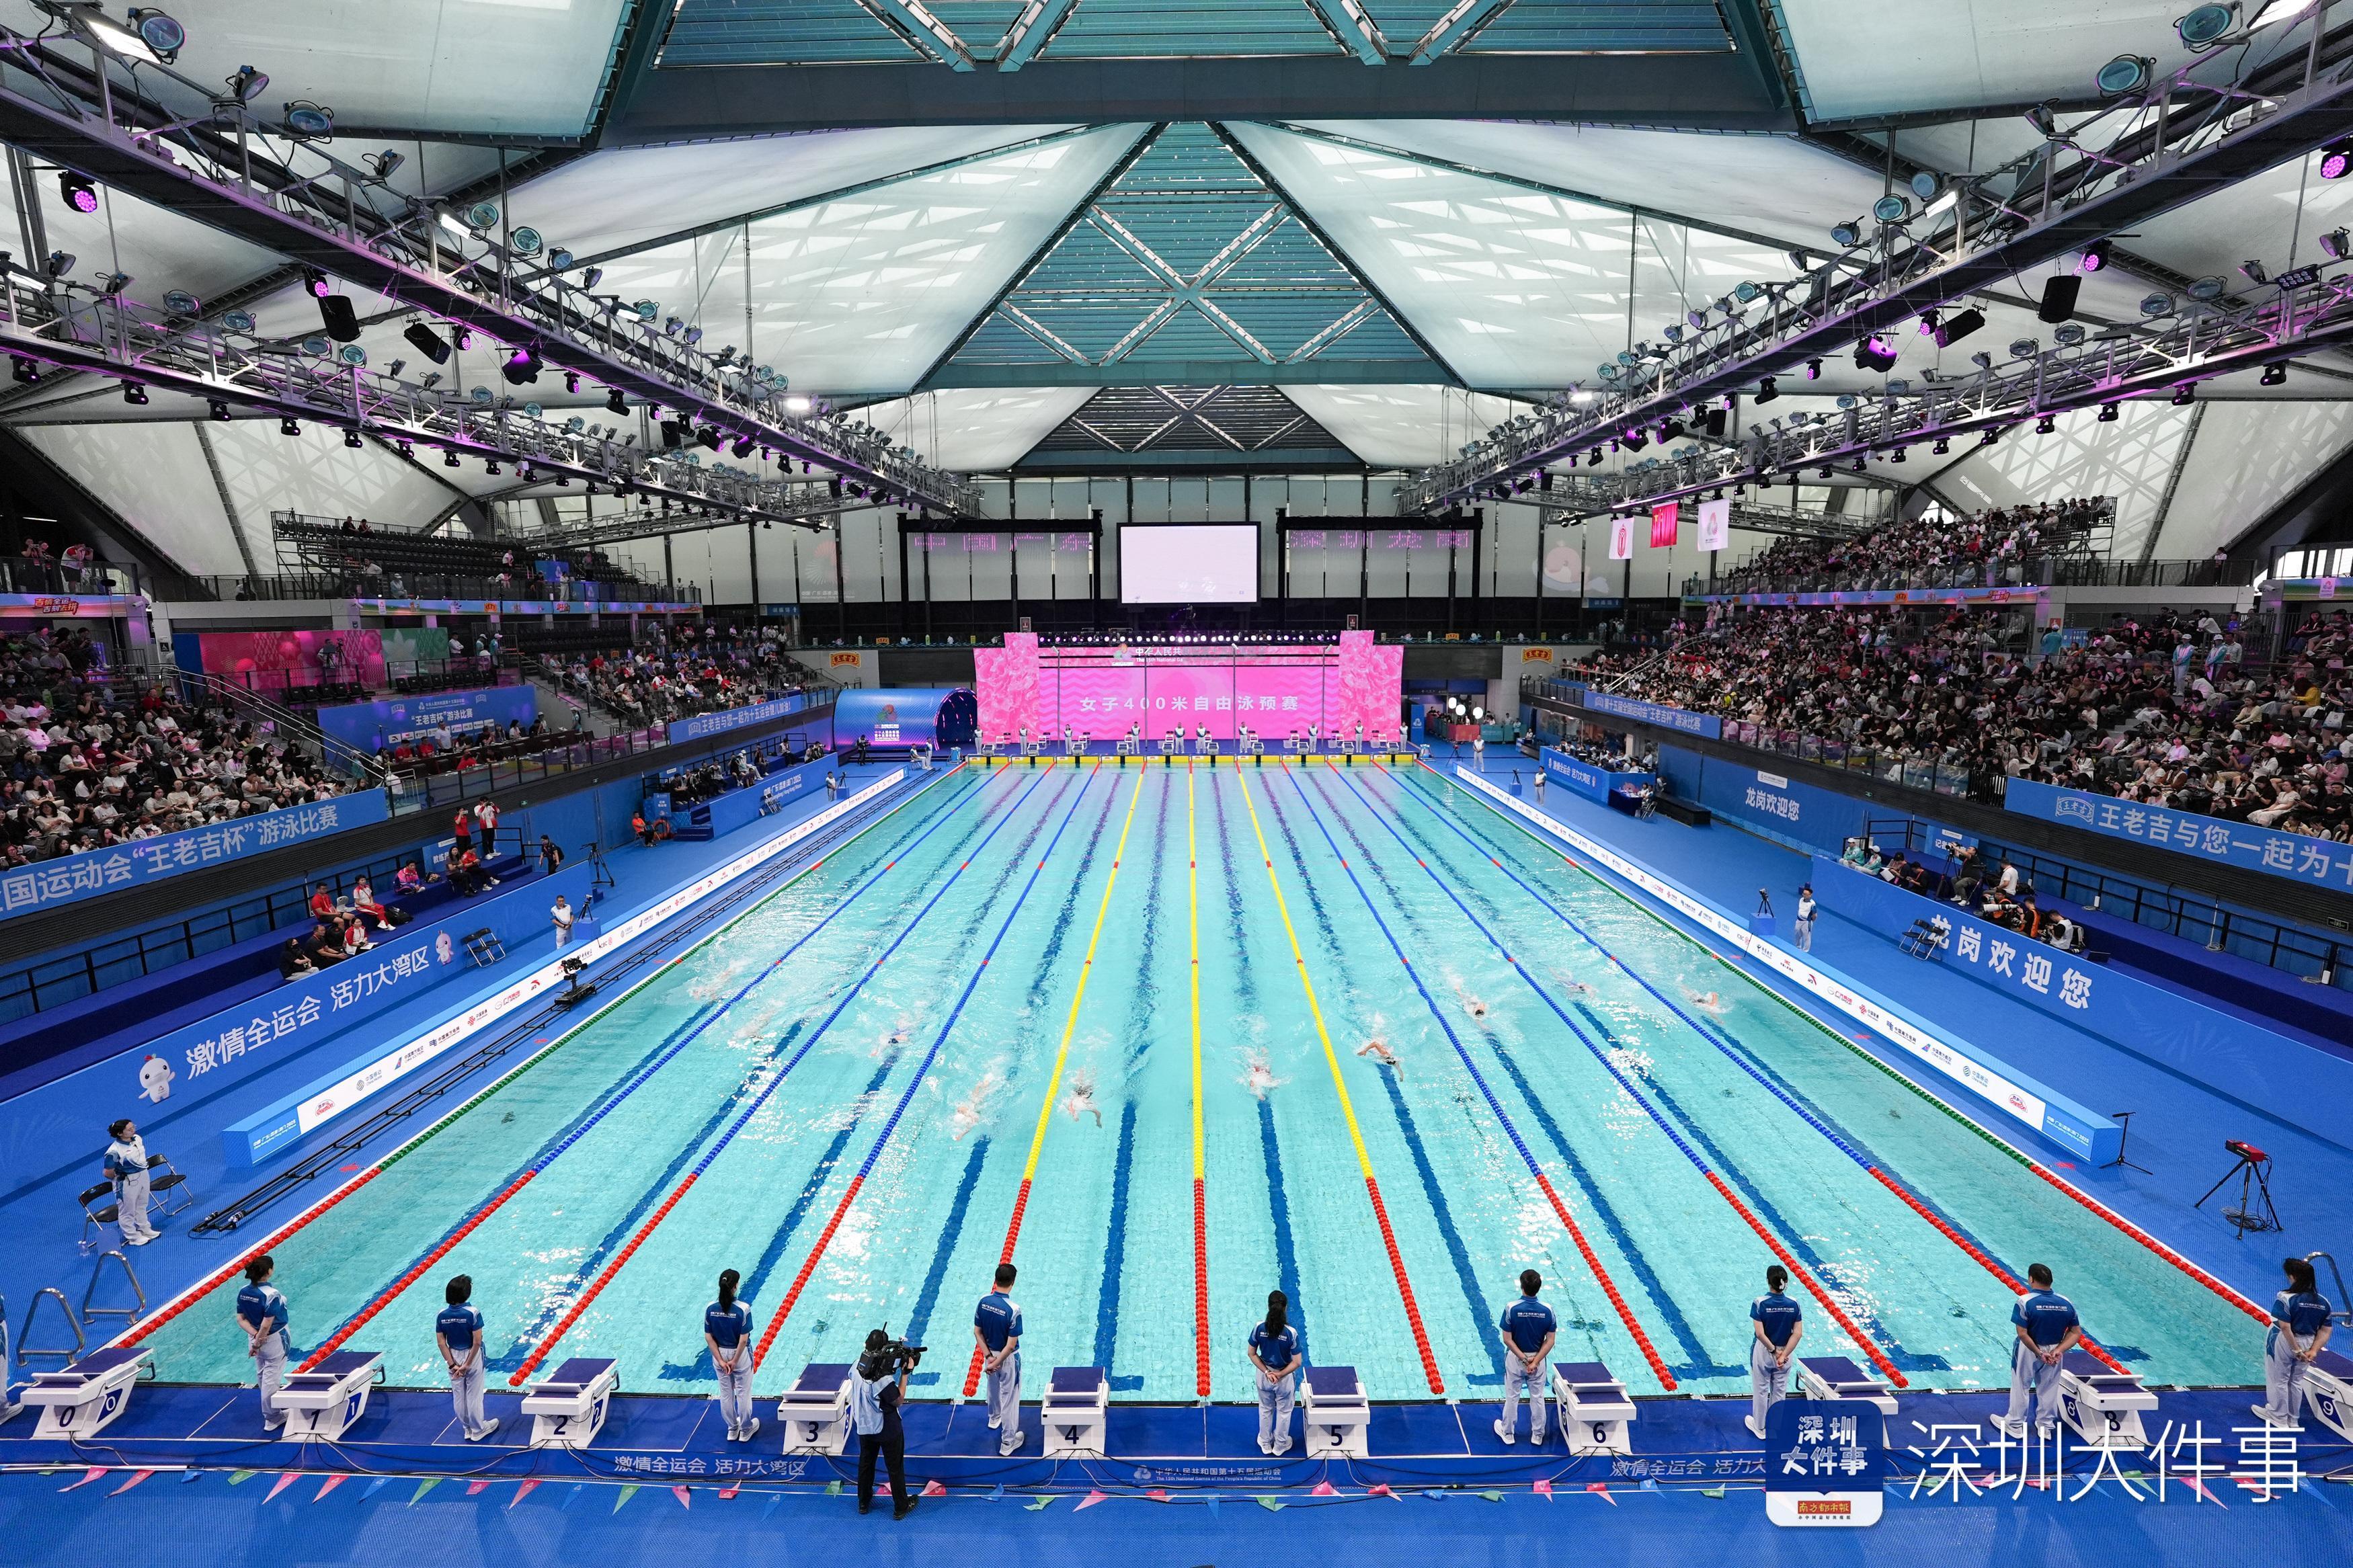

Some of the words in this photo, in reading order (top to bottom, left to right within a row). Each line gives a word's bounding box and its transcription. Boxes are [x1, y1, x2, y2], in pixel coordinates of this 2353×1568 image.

[1080, 696, 1298, 712] 女子400米自由泳预赛
[1746, 787, 1800, 821] 龙岗欢迎您
[0, 804, 338, 912] 国运动会“王老吉杯”游泳比赛
[1929, 914, 2092, 1009] 龙岗欢迎您
[187, 995, 321, 1080] 激情全运会
[330, 946, 430, 1012] 活力大湾区
[106, 1396, 116, 1411] 0
[350, 1401, 356, 1415] 1
[2067, 1401, 2075, 1416] 8
[2323, 1401, 2334, 1415] 9
[59, 1406, 75, 1428] 0
[311, 1409, 321, 1430] 1
[553, 1415, 568, 1435] 2
[594, 1407, 600, 1423] 2
[2104, 1411, 2120, 1432] 8
[805, 1421, 819, 1442] 3
[1065, 1425, 1079, 1444] 4
[1330, 1425, 1343, 1446] 5
[1593, 1421, 1607, 1443] 6
[614, 1456, 707, 1475] 激情全运会
[714, 1458, 805, 1476] 活力大湾区
[1156, 1467, 1281, 1476] 中华人民共和国第十五届运动会
[1609, 1458, 1706, 1477] 激情全运会
[1712, 1458, 1765, 1475] 活力大
